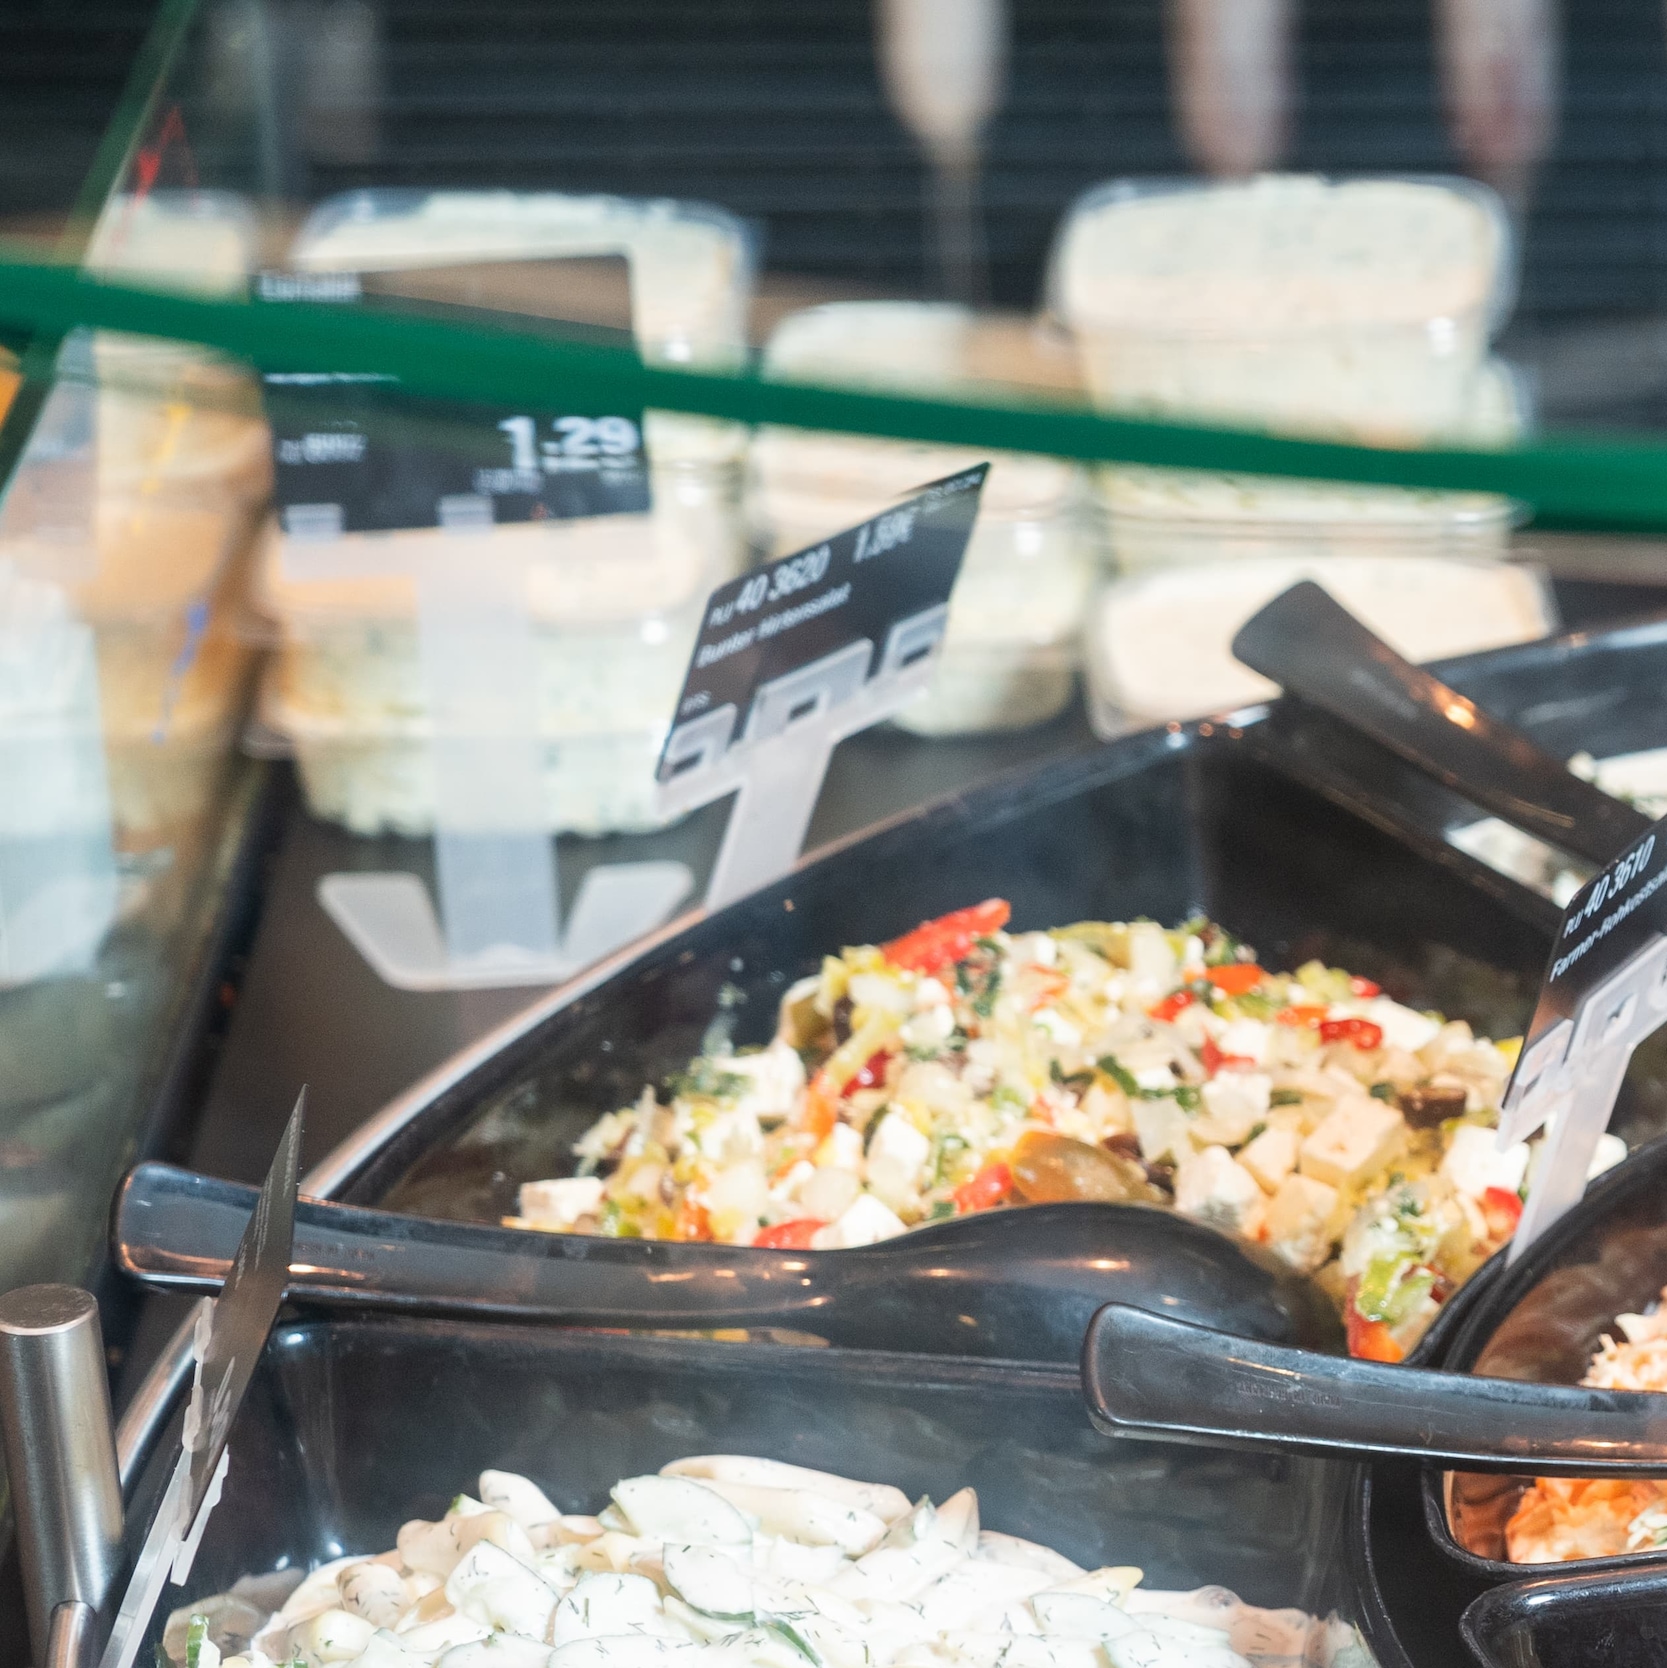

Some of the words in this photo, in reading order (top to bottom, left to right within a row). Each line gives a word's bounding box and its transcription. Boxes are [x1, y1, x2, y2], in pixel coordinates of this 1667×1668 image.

[735, 573, 768, 614] 40
[1583, 874, 1610, 919] 40
[1607, 834, 1656, 900] 3610
